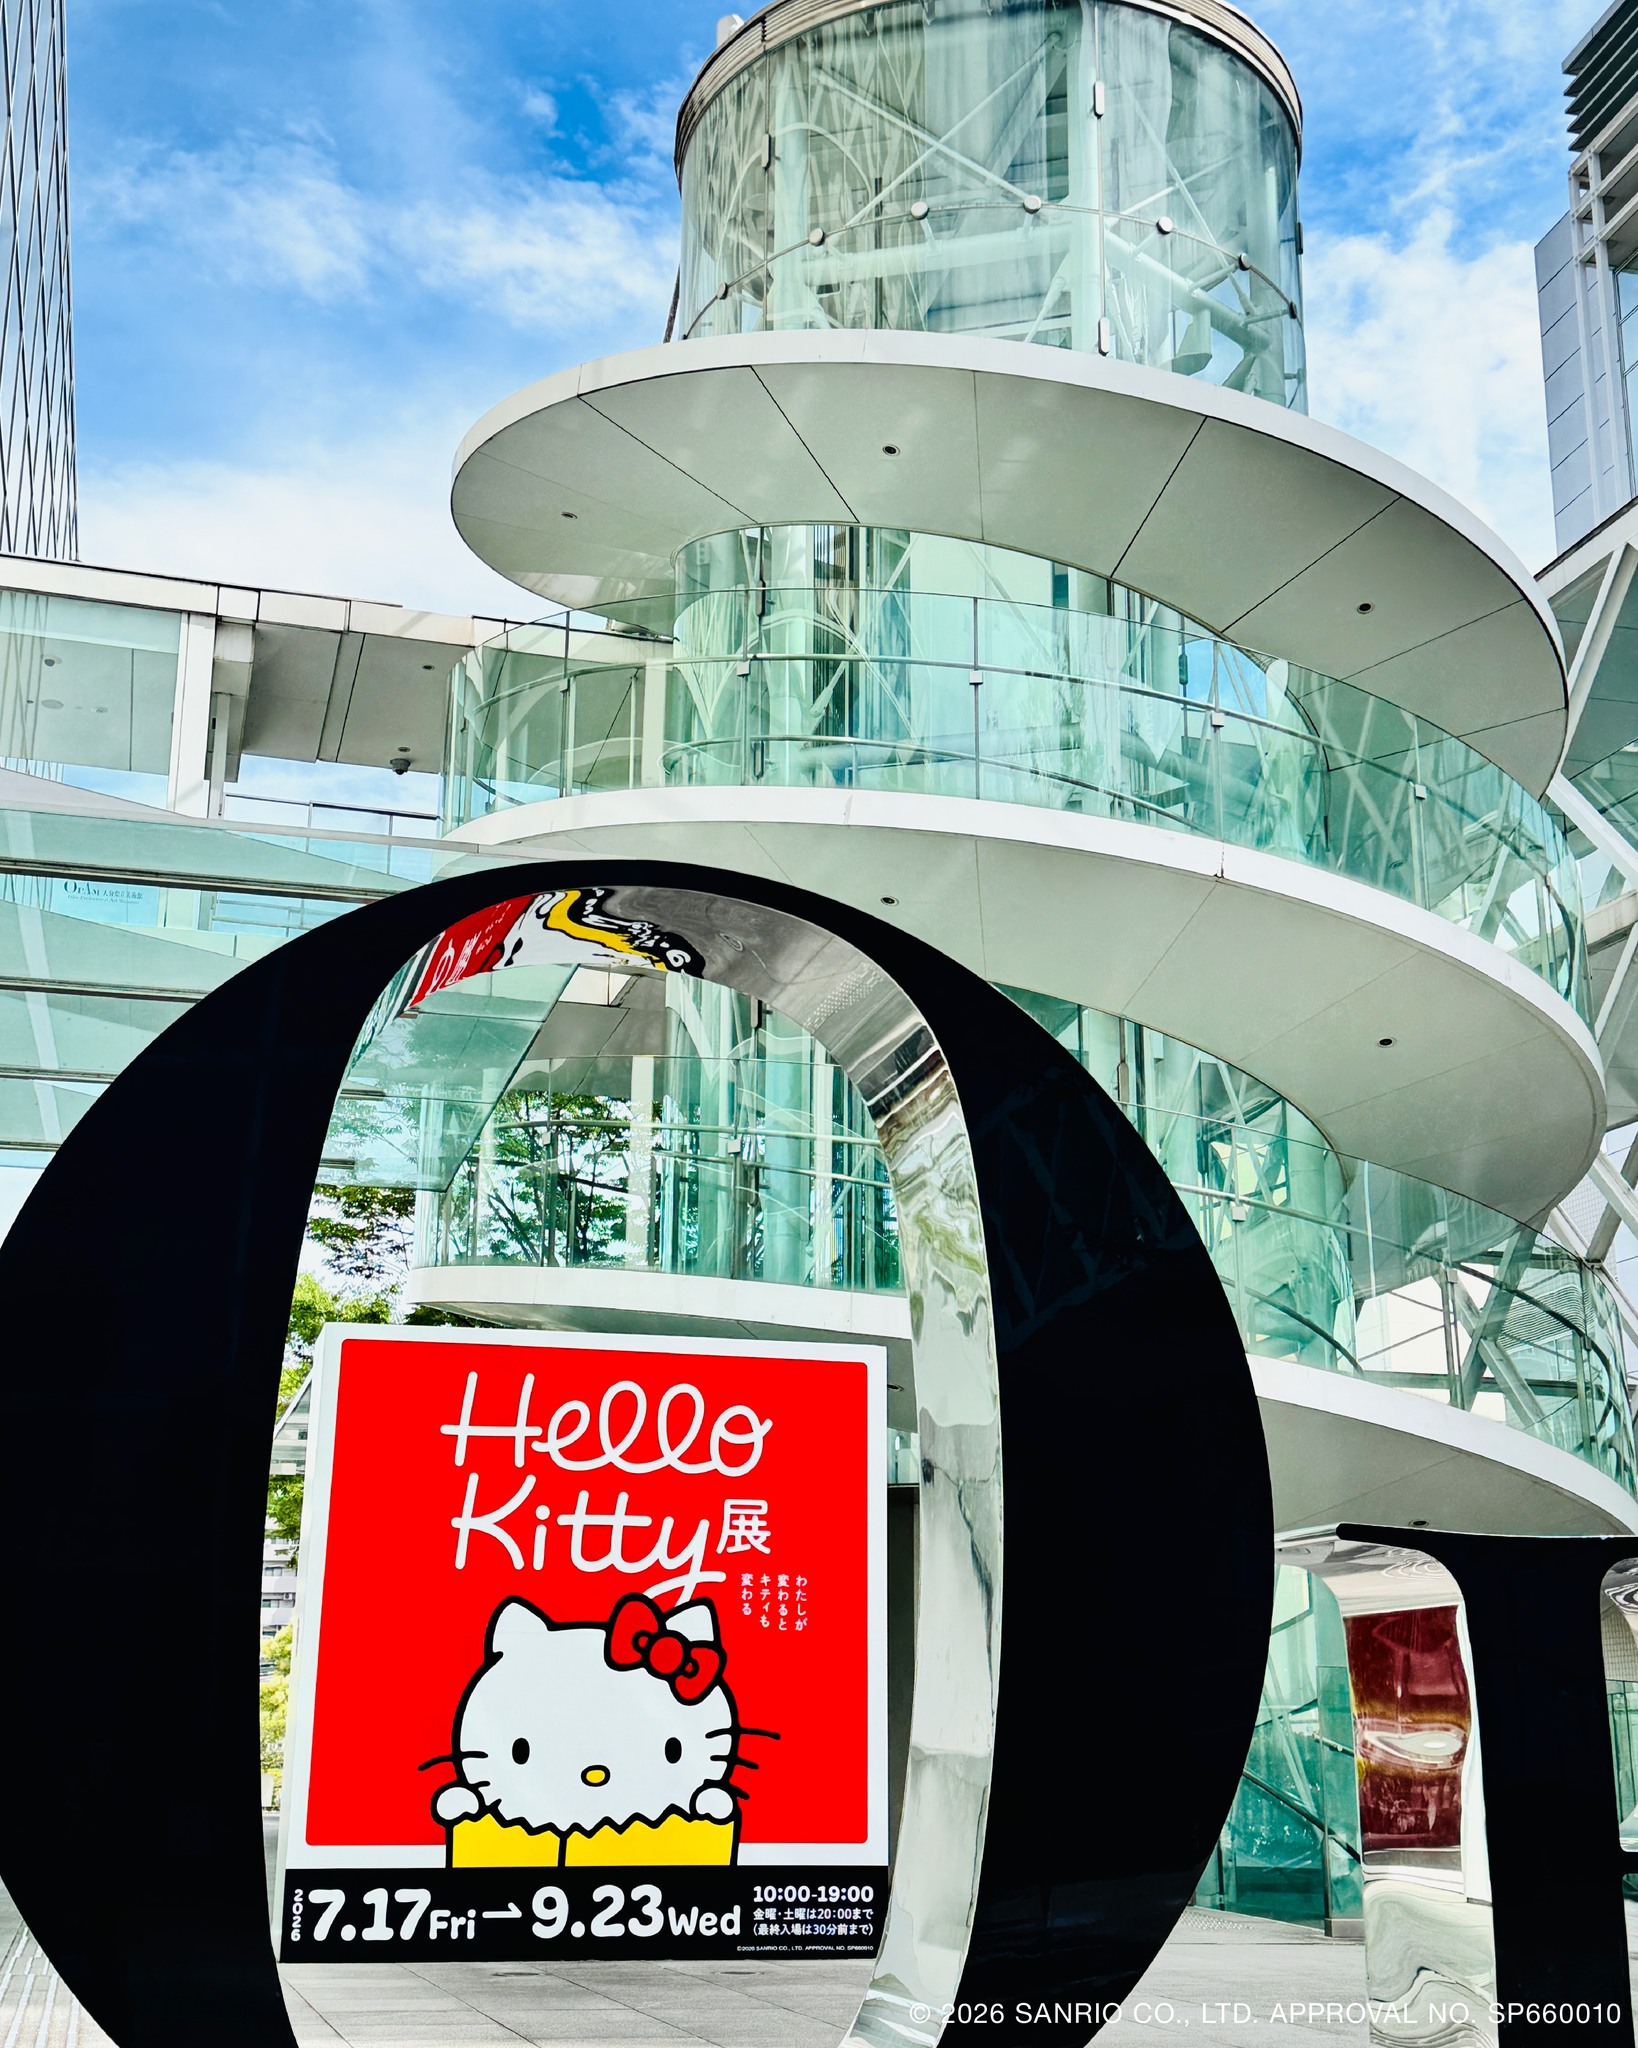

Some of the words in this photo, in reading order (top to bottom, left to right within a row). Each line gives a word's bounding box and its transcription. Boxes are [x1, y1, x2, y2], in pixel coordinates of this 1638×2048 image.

[440, 1371, 773, 1477] Hello
[741, 1573, 754, 1616] 変わる
[759, 1573, 771, 1628] キティも
[777, 1573, 790, 1631] 変わると
[795, 1574, 808, 1631] わたしが
[290, 1888, 304, 1942] 2026
[753, 1885, 874, 1903] 10:00-19:00
